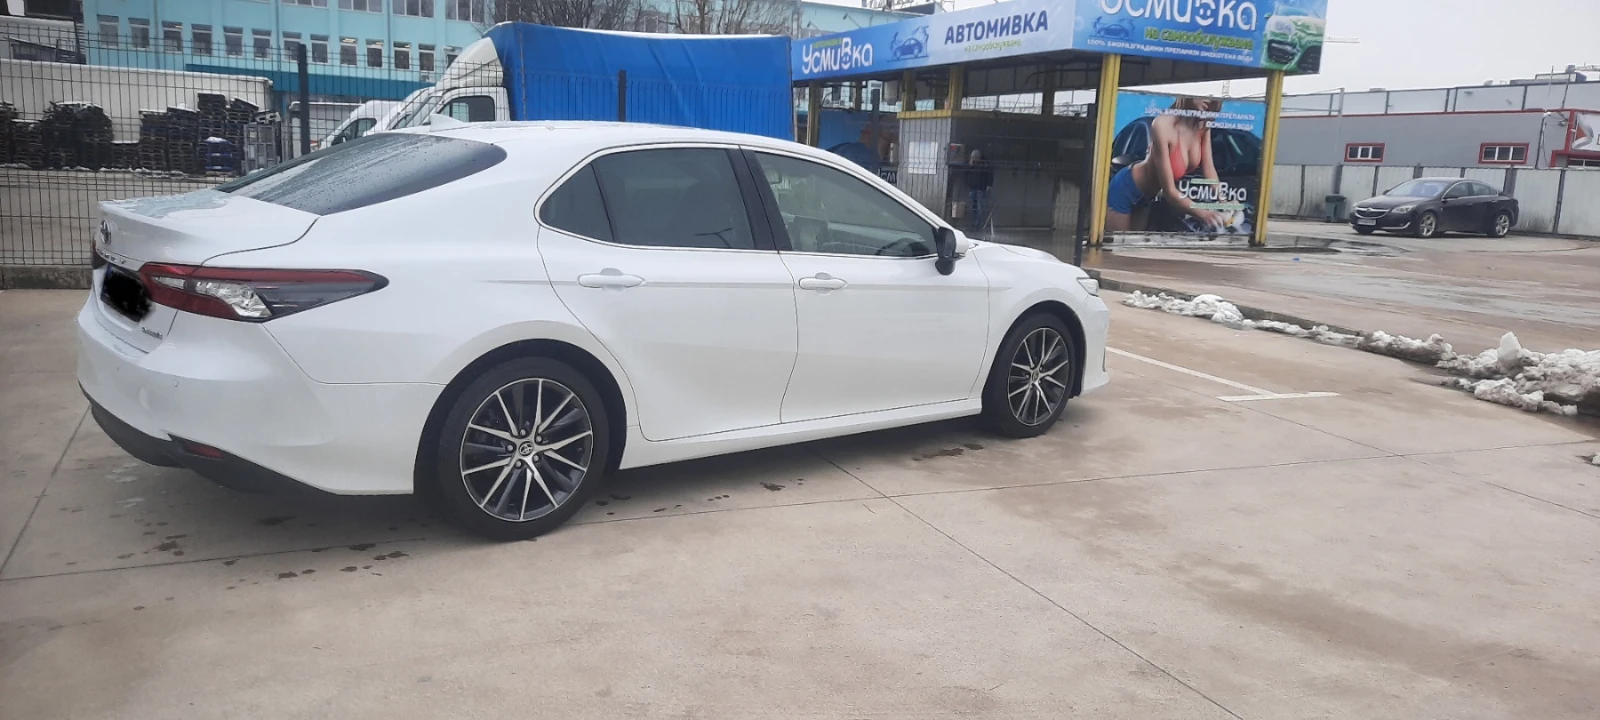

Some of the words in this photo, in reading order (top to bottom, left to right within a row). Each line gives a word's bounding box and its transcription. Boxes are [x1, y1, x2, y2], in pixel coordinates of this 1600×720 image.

[944, 9, 1049, 46] АВТОМИВКА
[1086, 38, 1106, 46] 100%
[1144, 107, 1163, 115] 100%
[1237, 122, 1254, 131] ВОДА
